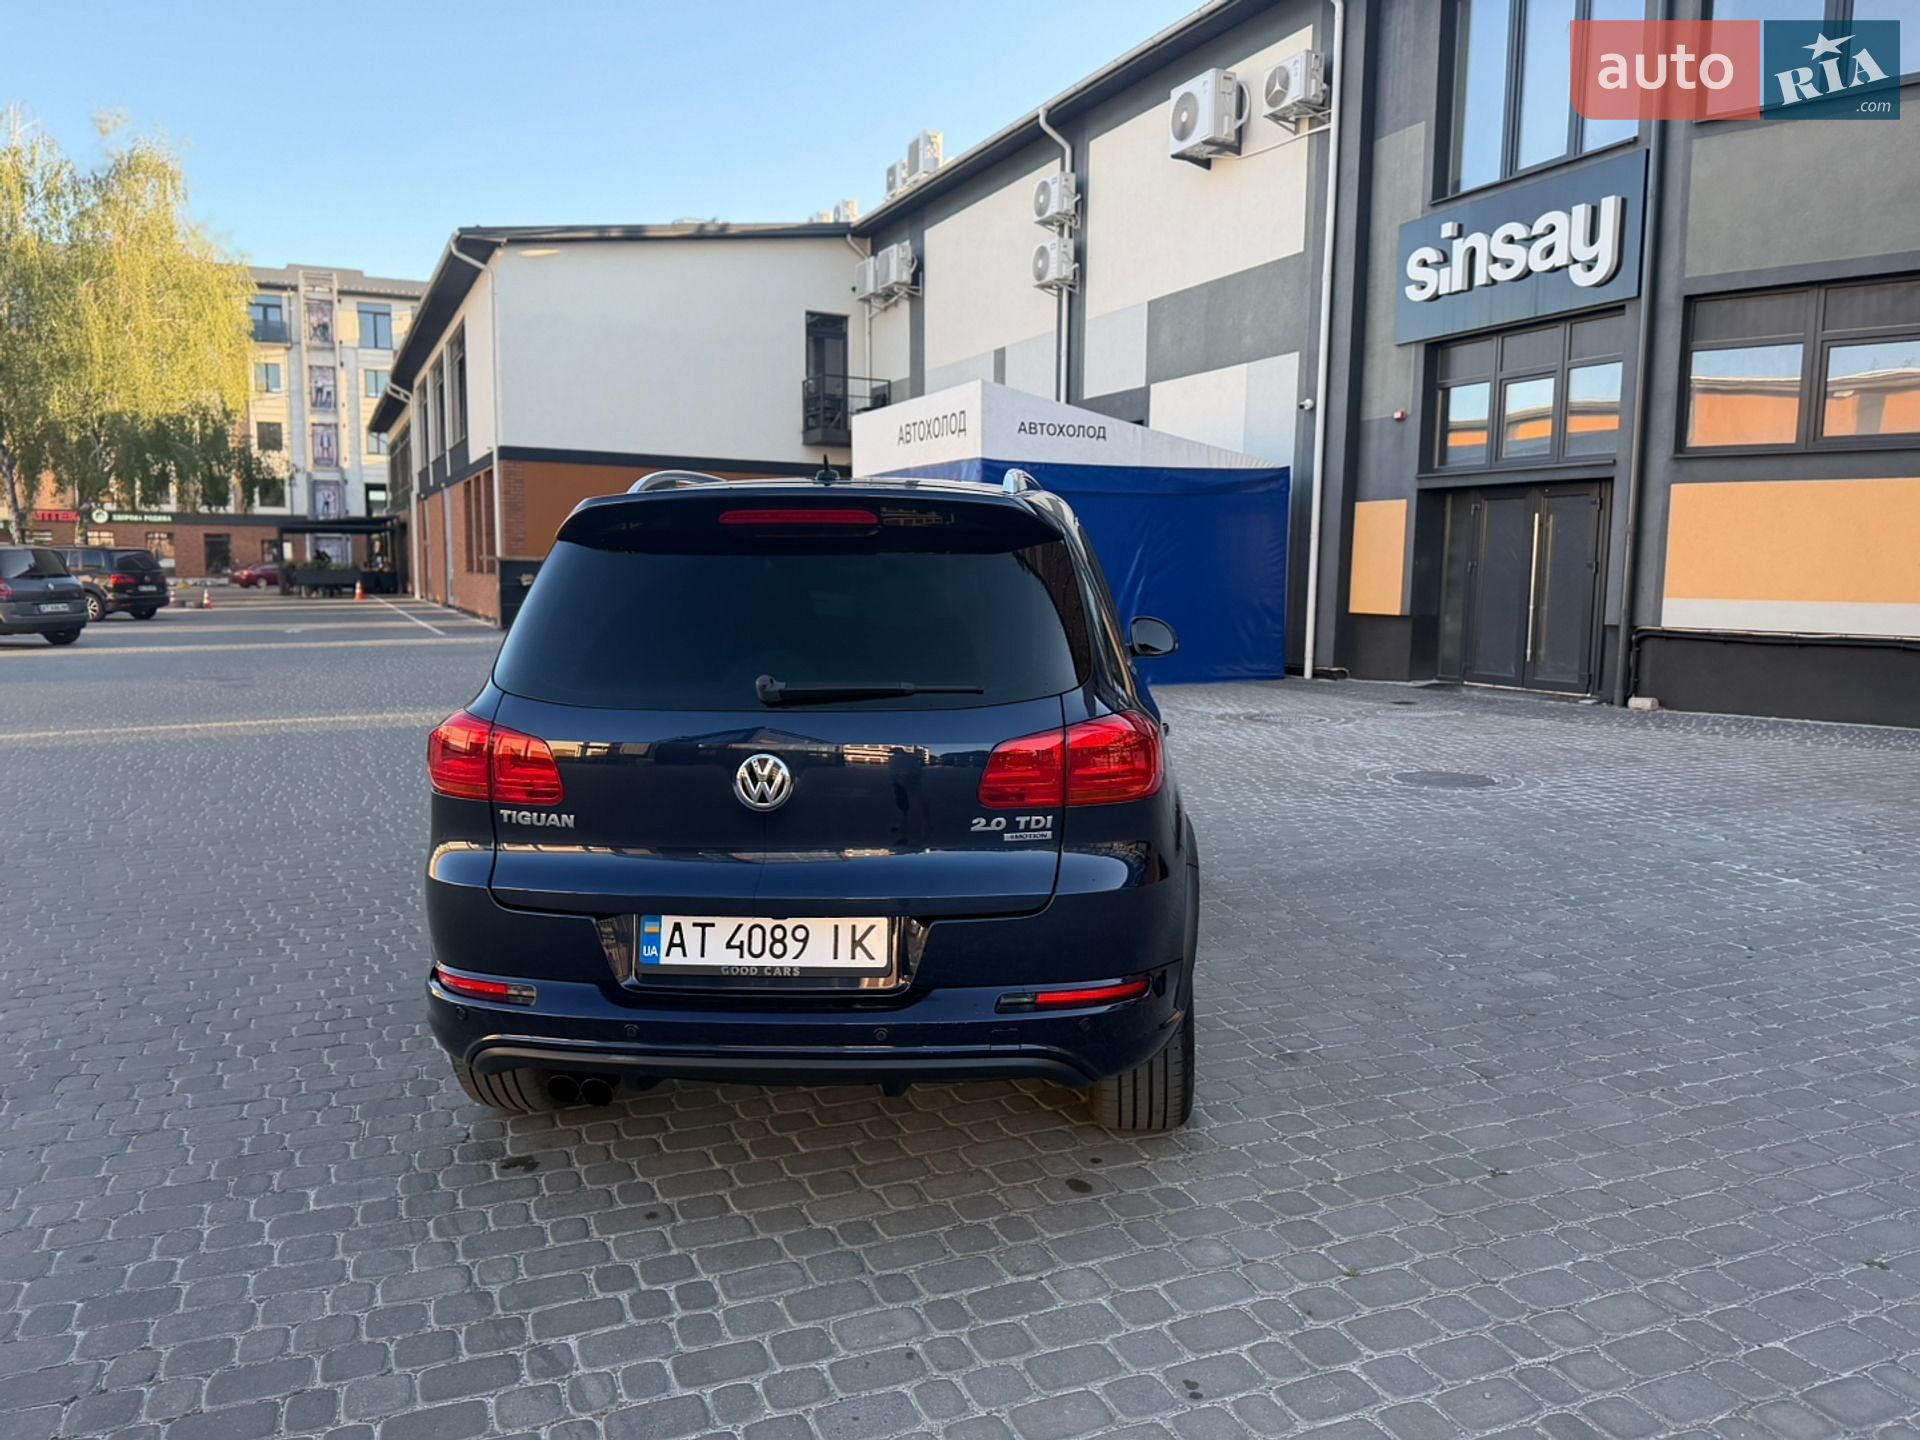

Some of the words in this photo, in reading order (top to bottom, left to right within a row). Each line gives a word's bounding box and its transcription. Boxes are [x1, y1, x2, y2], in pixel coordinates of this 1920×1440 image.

[1405, 195, 1622, 302] sinsay
[898, 410, 967, 445] АВТОХОЛОД
[1018, 421, 1107, 440] АВТОХОЛОД
[499, 809, 575, 828] TIGUAN
[1015, 815, 1053, 830] TDI
[665, 921, 716, 958] AT
[725, 923, 810, 960] 4089
[832, 924, 876, 961] IK
[643, 946, 658, 957] UA
[721, 966, 758, 976] GOOD
[764, 966, 801, 977] CARS
